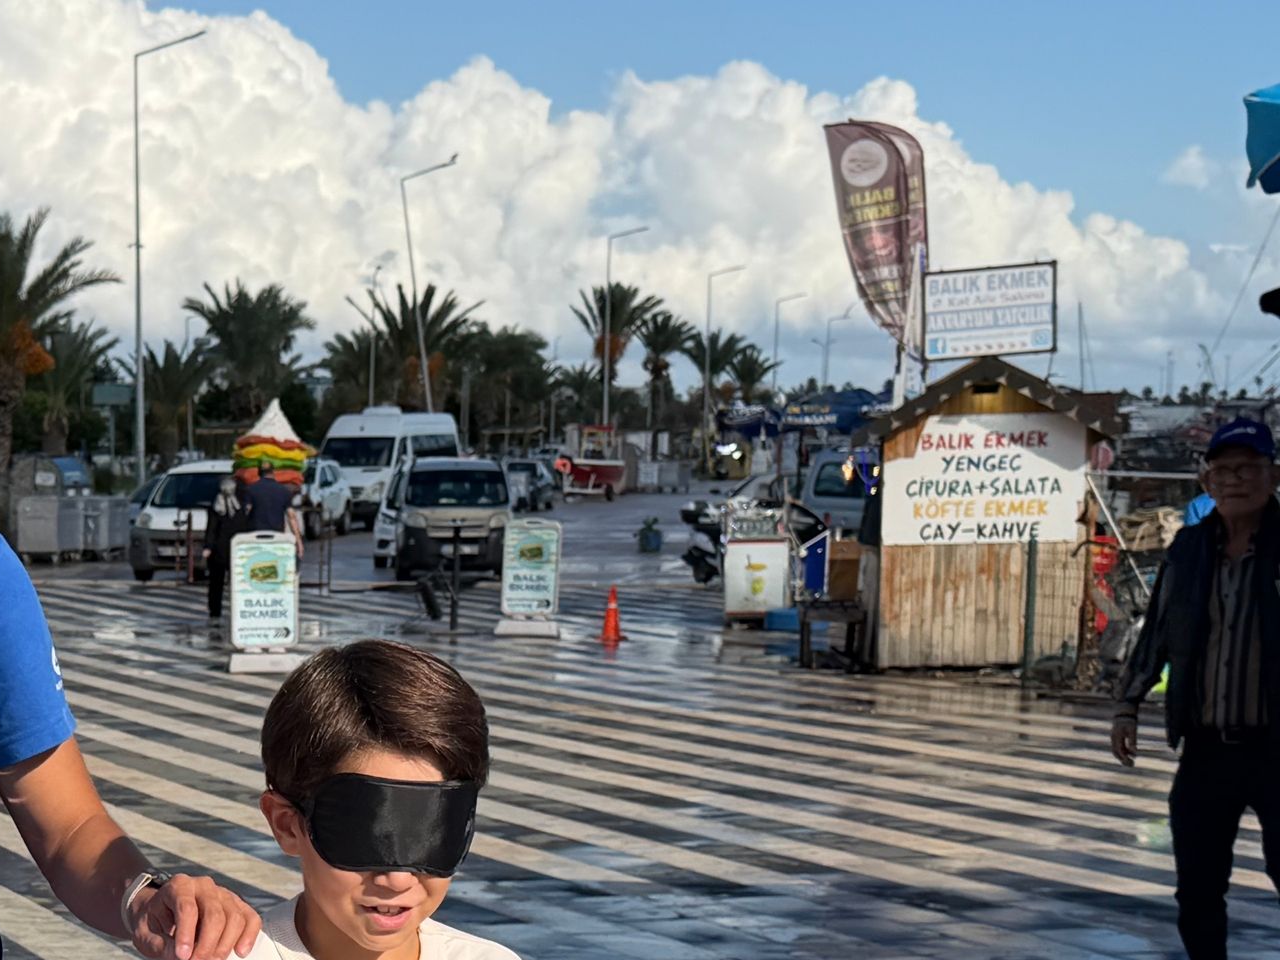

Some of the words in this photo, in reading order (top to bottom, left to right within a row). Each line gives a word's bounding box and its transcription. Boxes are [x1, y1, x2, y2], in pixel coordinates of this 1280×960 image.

[928, 275, 981, 297] BALIK
[986, 268, 1050, 292] EKMEK
[921, 431, 975, 451] BALIK
[983, 429, 1049, 449] EKMEK
[912, 498, 976, 520] KÖFTE
[983, 499, 1049, 518] EKMEK
[239, 609, 289, 619] EKMEK
[243, 599, 284, 608] BALIK
